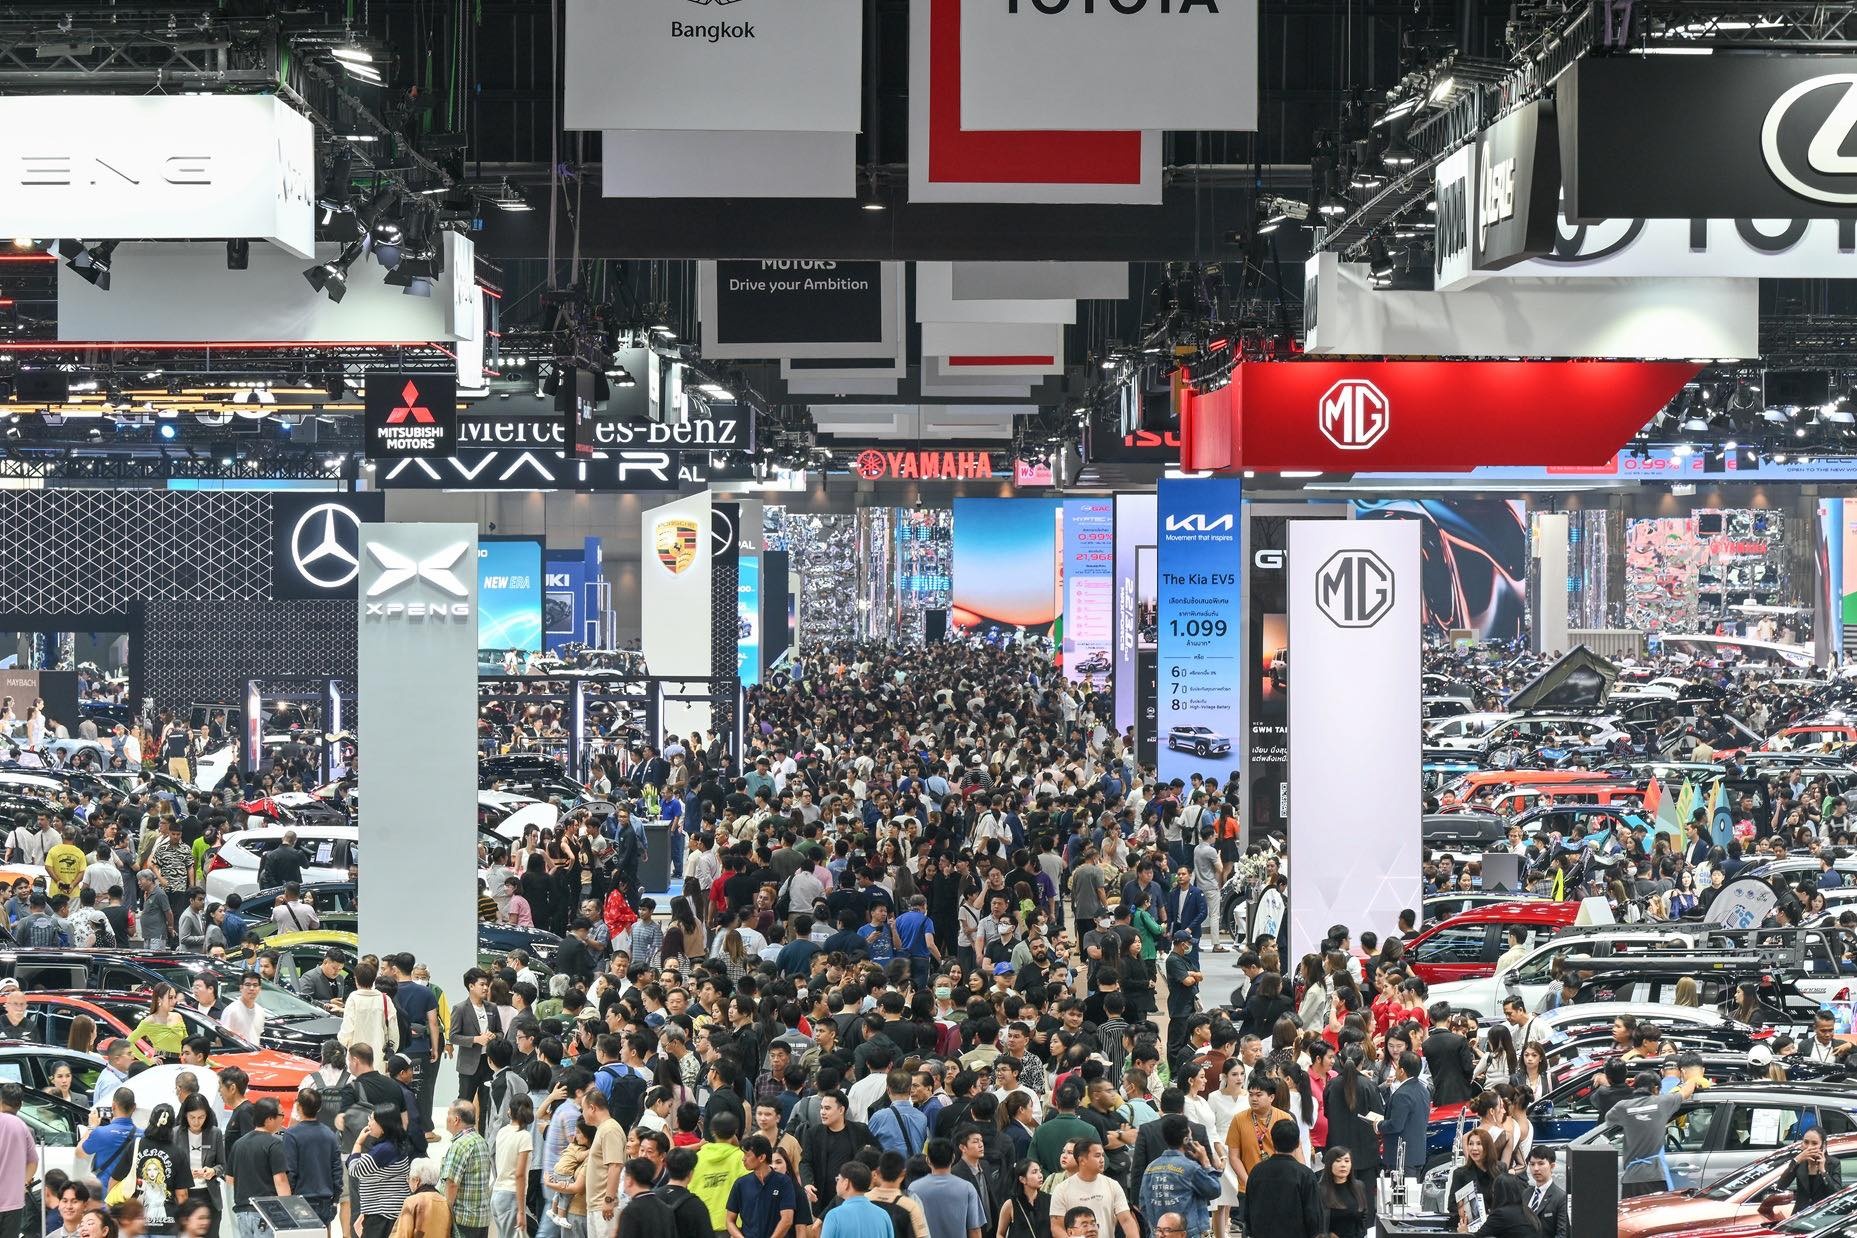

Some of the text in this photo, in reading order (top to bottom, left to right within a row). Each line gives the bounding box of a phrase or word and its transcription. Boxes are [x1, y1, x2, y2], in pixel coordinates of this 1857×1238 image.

[671, 21, 755, 42] Bangkok
[729, 277, 868, 295] Drive your Ambition
[1326, 386, 1382, 443] MG
[377, 426, 444, 438] MITSUBISHI
[386, 438, 435, 449] MOTORS
[887, 453, 992, 480] YAMAHA
[1166, 514, 1234, 531] KIA
[1211, 534, 1233, 542] inspires
[484, 576, 508, 589] NEW
[1163, 574, 1235, 585] The Kia EV5
[1323, 556, 1388, 621] MG
[366, 602, 470, 616] XPENG
[1169, 619, 1227, 637] 1.099
[1171, 665, 1180, 678] 6
[6, 678, 36, 688] MAYBACH
[1171, 683, 1180, 695] 7
[1171, 698, 1180, 711] 8
[1252, 726, 1273, 734] GWM
